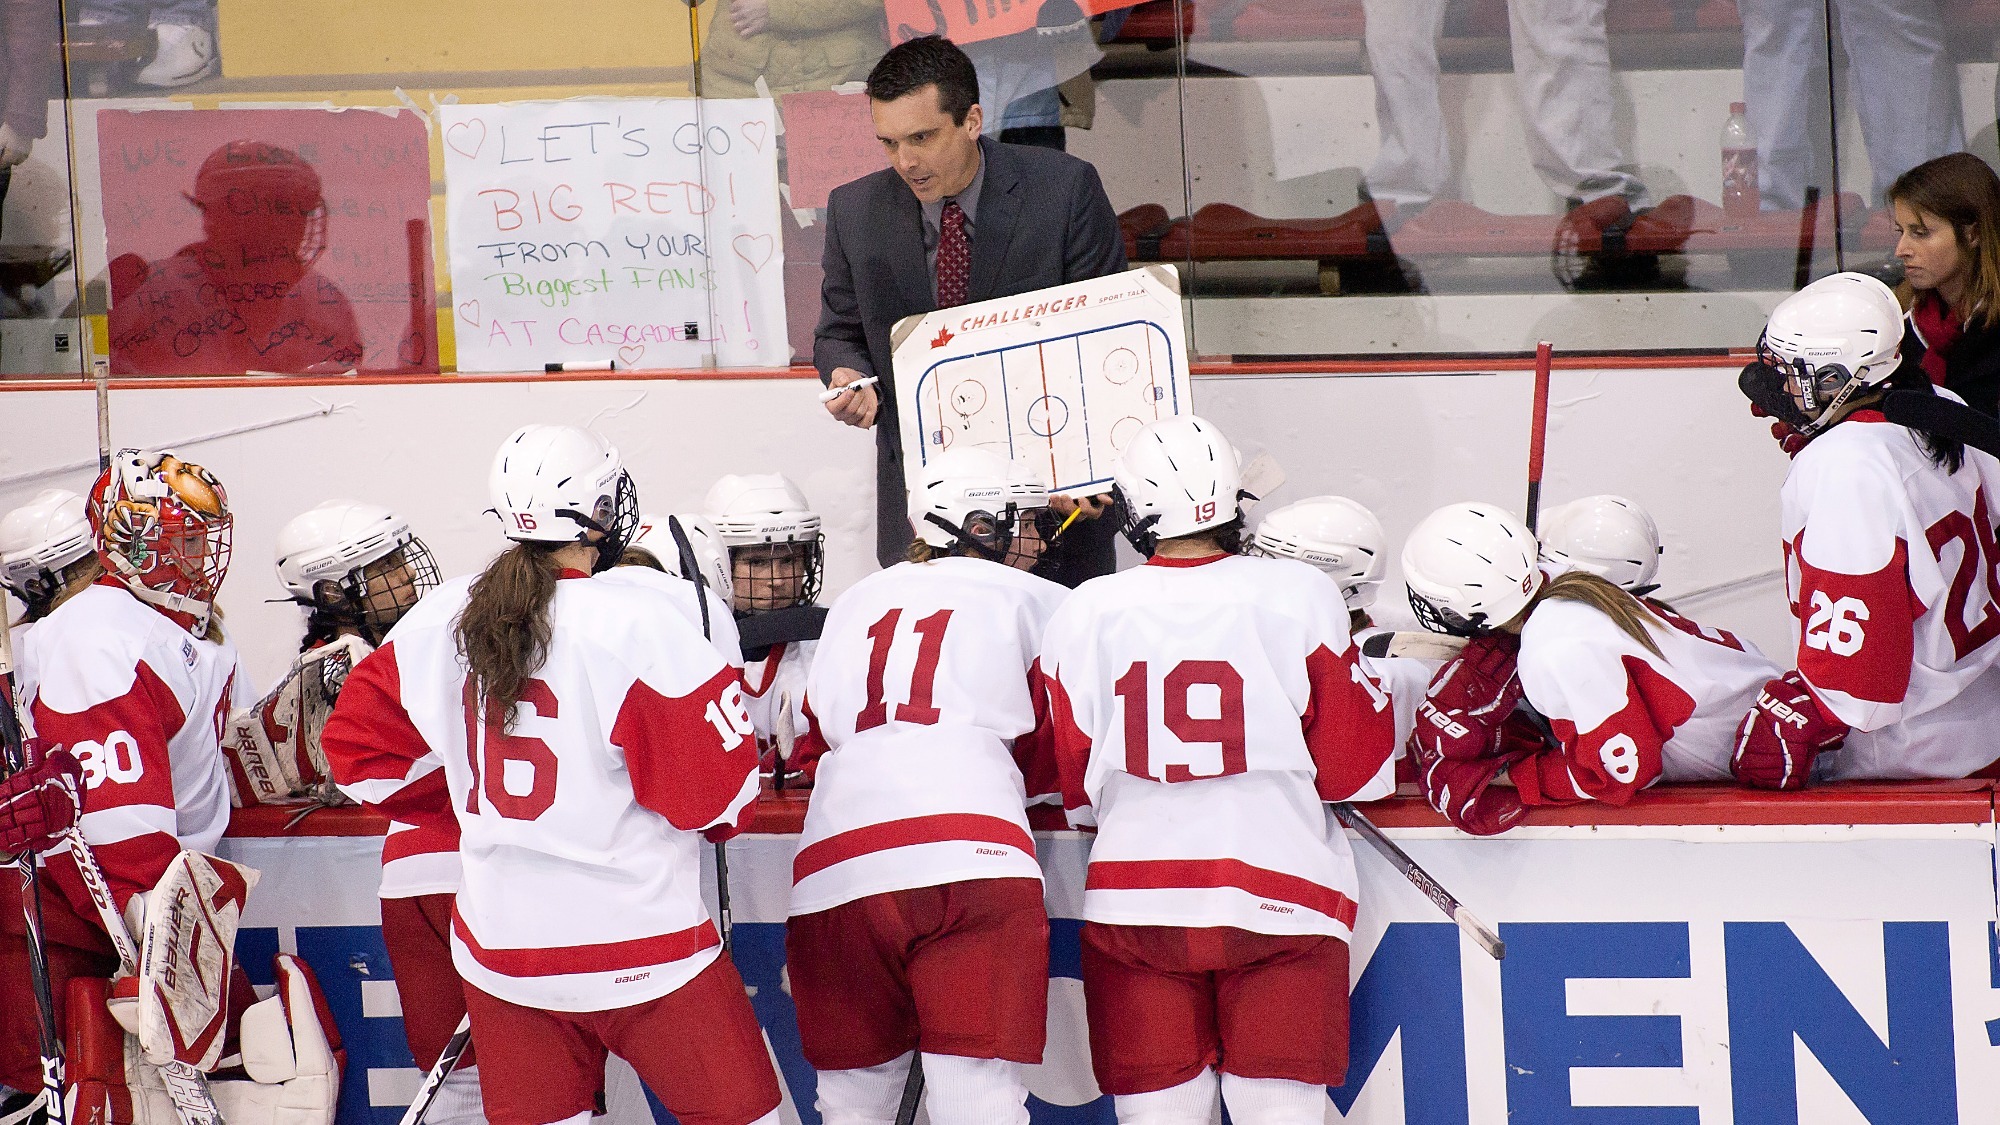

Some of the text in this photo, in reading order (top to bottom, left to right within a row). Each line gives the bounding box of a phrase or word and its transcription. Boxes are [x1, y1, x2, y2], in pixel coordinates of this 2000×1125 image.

[500, 115, 732, 165] LET'S GO
[477, 184, 584, 232] BIG
[625, 232, 711, 260] YOUR
[620, 266, 718, 292] FANS
[960, 288, 1146, 332] CHALLENGER SPORT TALK
[487, 318, 538, 348] AT
[968, 489, 1001, 498] BAUER
[512, 512, 538, 530] 16
[1194, 501, 1216, 523] 19
[761, 525, 796, 533] BAUER
[305, 559, 333, 574] BAUER
[1306, 554, 1339, 563] BAUER
[716, 562, 731, 590] BAUER
[1522, 573, 1532, 593] 8
[1806, 589, 1870, 657] 26
[855, 608, 954, 733] 11
[1115, 659, 1248, 784] 19
[71, 730, 144, 790] 30
[237, 726, 277, 795] BAUER
[463, 671, 559, 822] 16
[1599, 733, 1640, 784] 8
[975, 847, 1008, 857] BAUER
[1259, 903, 1295, 915] BAUER
[164, 886, 190, 991] BAUER
[614, 971, 651, 984] BAUER
